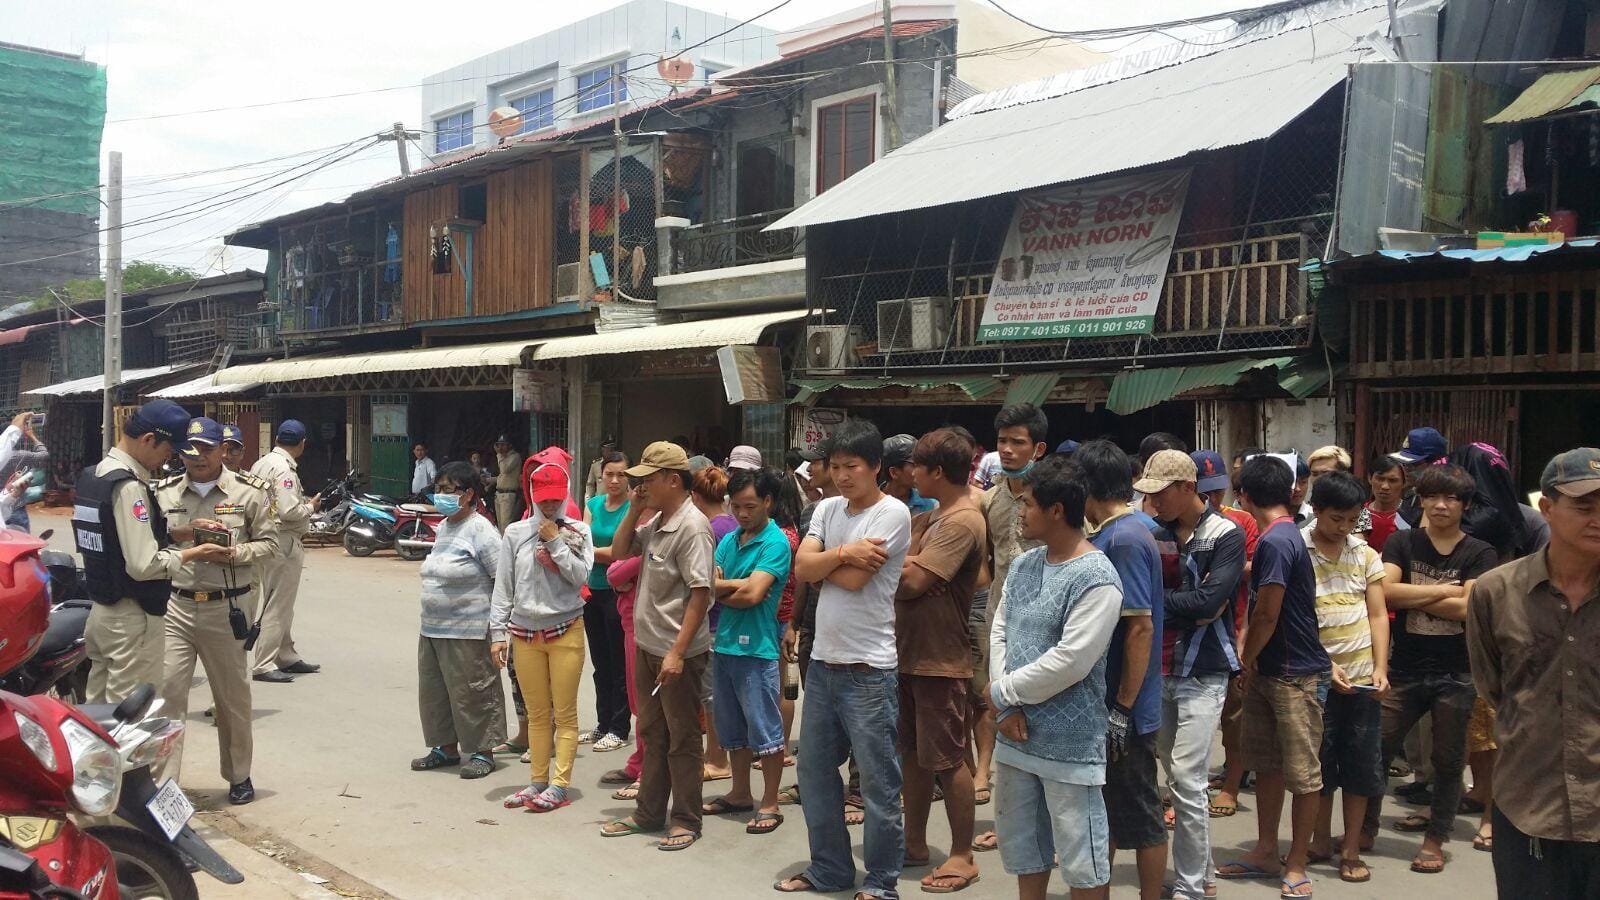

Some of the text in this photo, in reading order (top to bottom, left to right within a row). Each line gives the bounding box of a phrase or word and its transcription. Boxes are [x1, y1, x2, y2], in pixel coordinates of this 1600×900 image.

[1022, 221, 1154, 253] VANN NORN
[1042, 282, 1054, 295] CD
[1064, 298, 1072, 307] &
[1132, 292, 1148, 302] CD
[984, 328, 1000, 337] Tel:
[1002, 326, 1020, 336] 097
[1023, 326, 1029, 336] 7
[1031, 325, 1050, 336] 401
[1052, 324, 1070, 335] 536
[1078, 322, 1099, 333] 011
[1102, 321, 1122, 332] 901
[1125, 320, 1147, 331] 926
